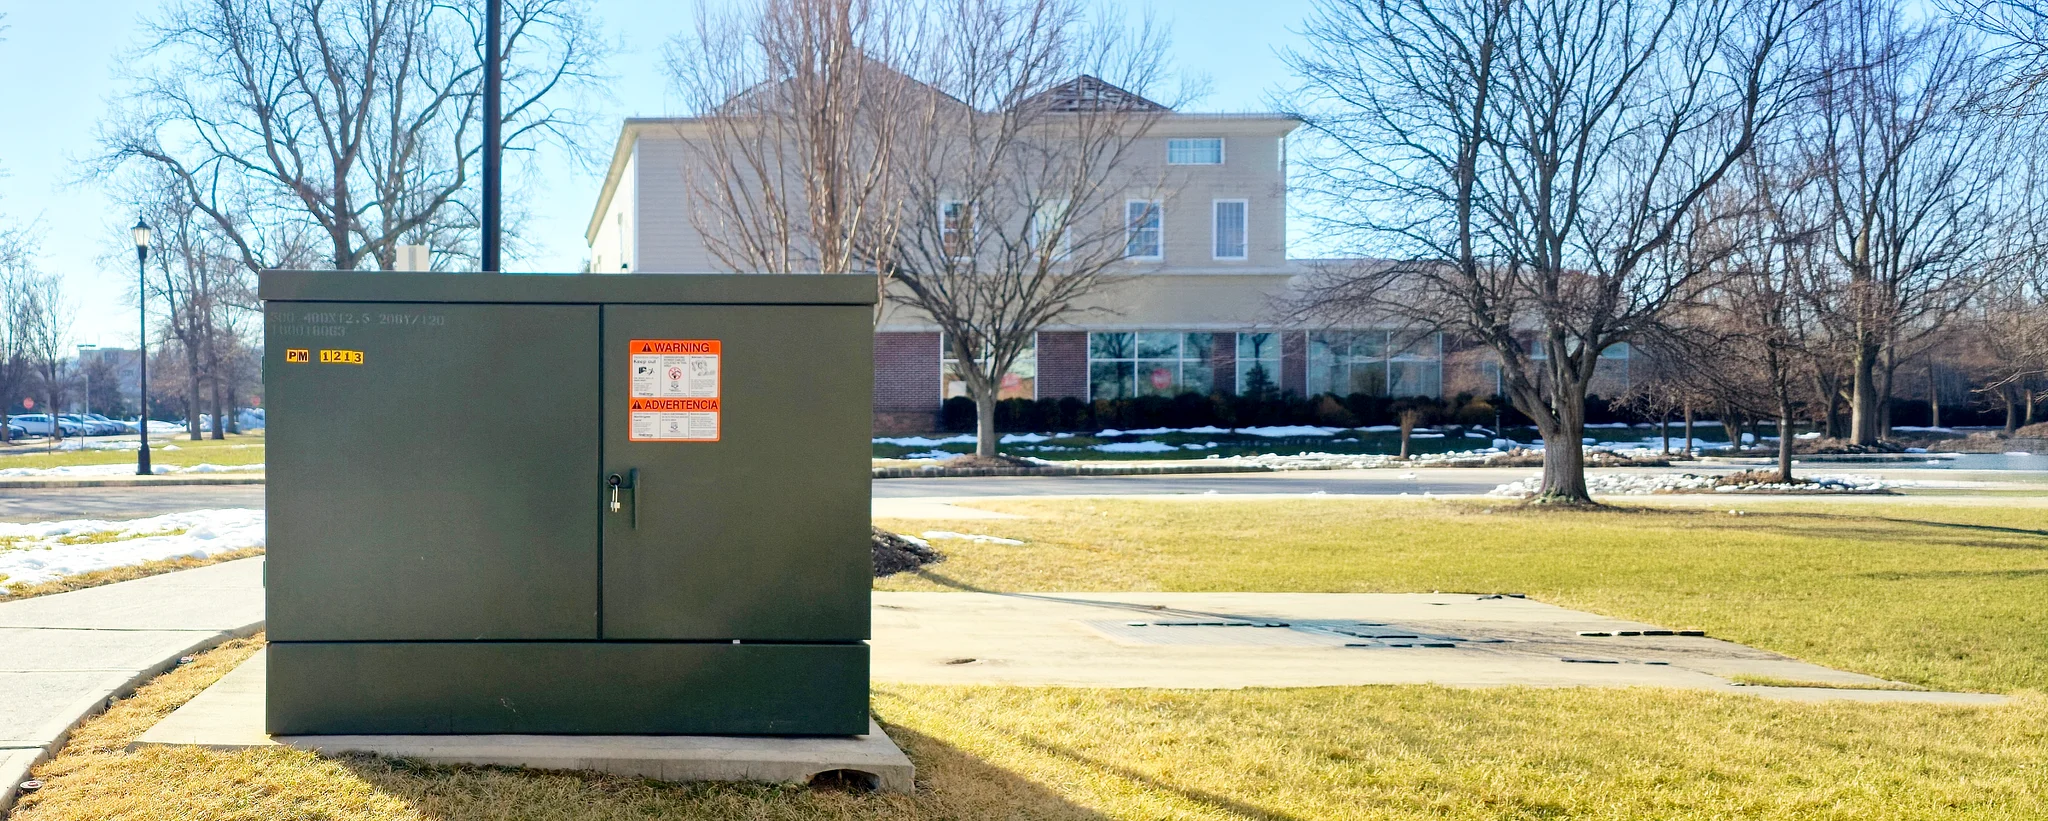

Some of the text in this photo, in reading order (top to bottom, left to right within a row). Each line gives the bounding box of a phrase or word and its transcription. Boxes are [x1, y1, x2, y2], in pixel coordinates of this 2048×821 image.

[654, 342, 710, 353] WARNING
[289, 351, 362, 363] PM 1213
[644, 399, 718, 410] ADVERTENCIA
